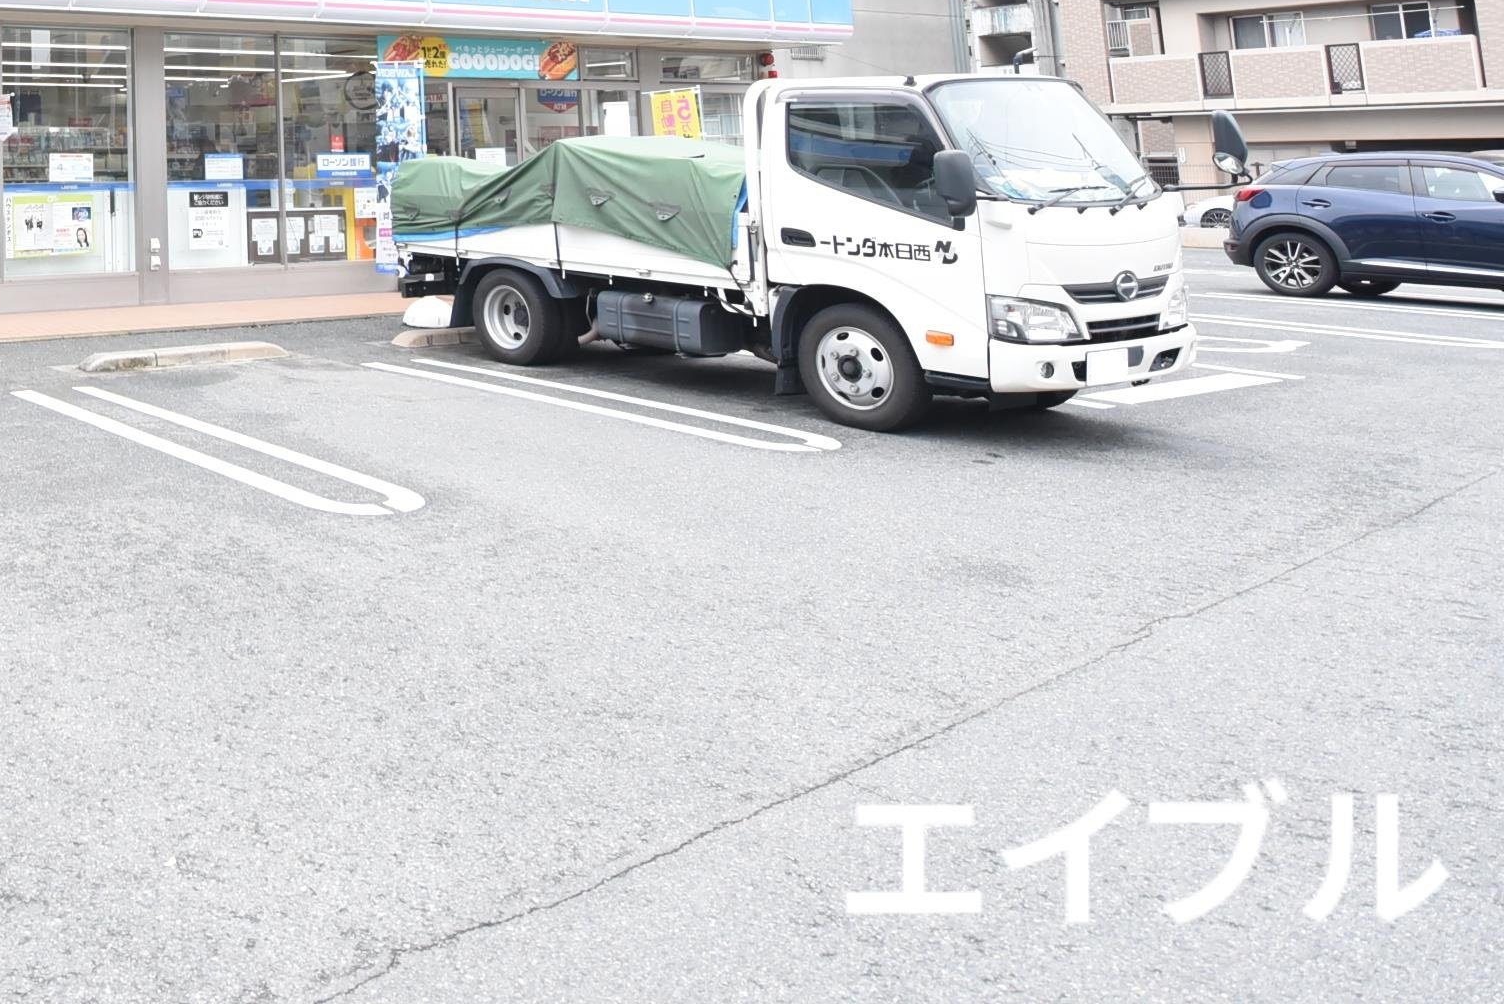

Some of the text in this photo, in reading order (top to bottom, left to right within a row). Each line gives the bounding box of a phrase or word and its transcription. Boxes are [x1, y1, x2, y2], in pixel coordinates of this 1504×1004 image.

[322, 157, 365, 167] ローソン銀行
